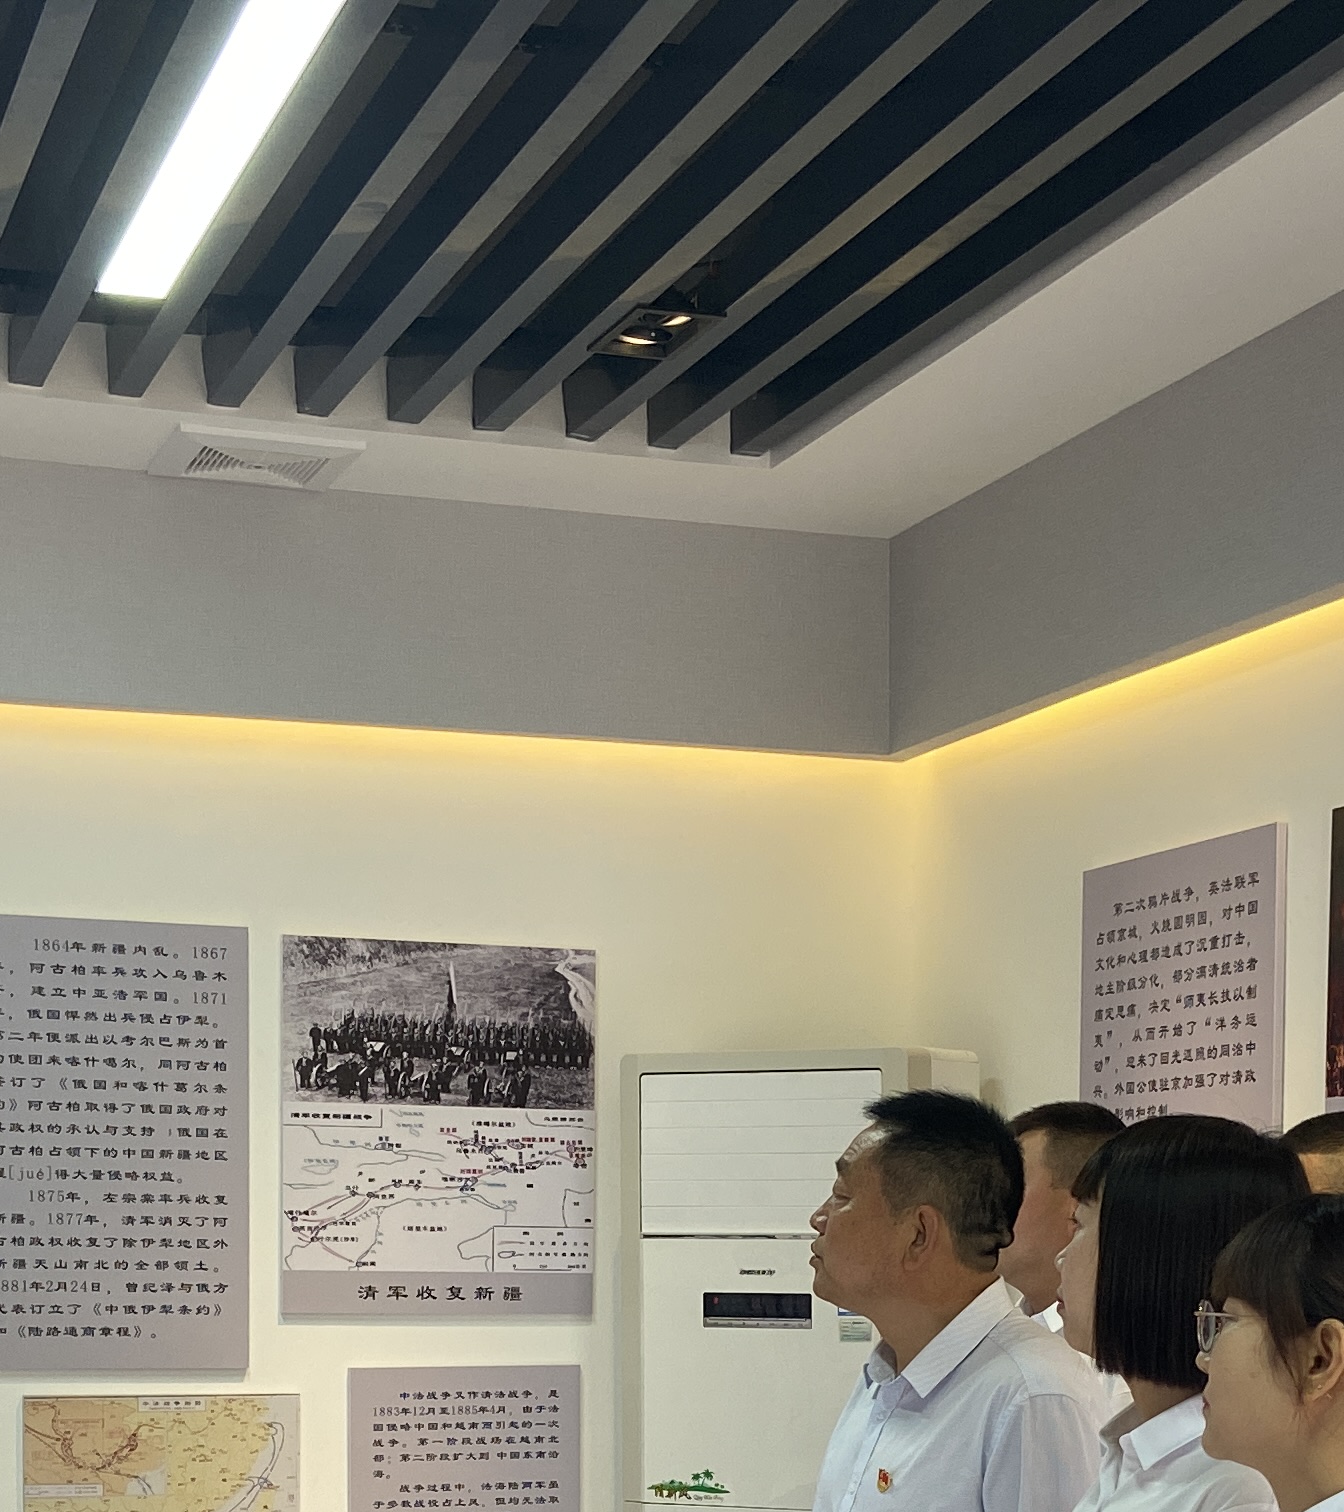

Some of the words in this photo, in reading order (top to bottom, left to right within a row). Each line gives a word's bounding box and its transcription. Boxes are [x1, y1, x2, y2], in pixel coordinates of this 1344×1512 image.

[358, 1284, 524, 1302] 清军收复新疆
